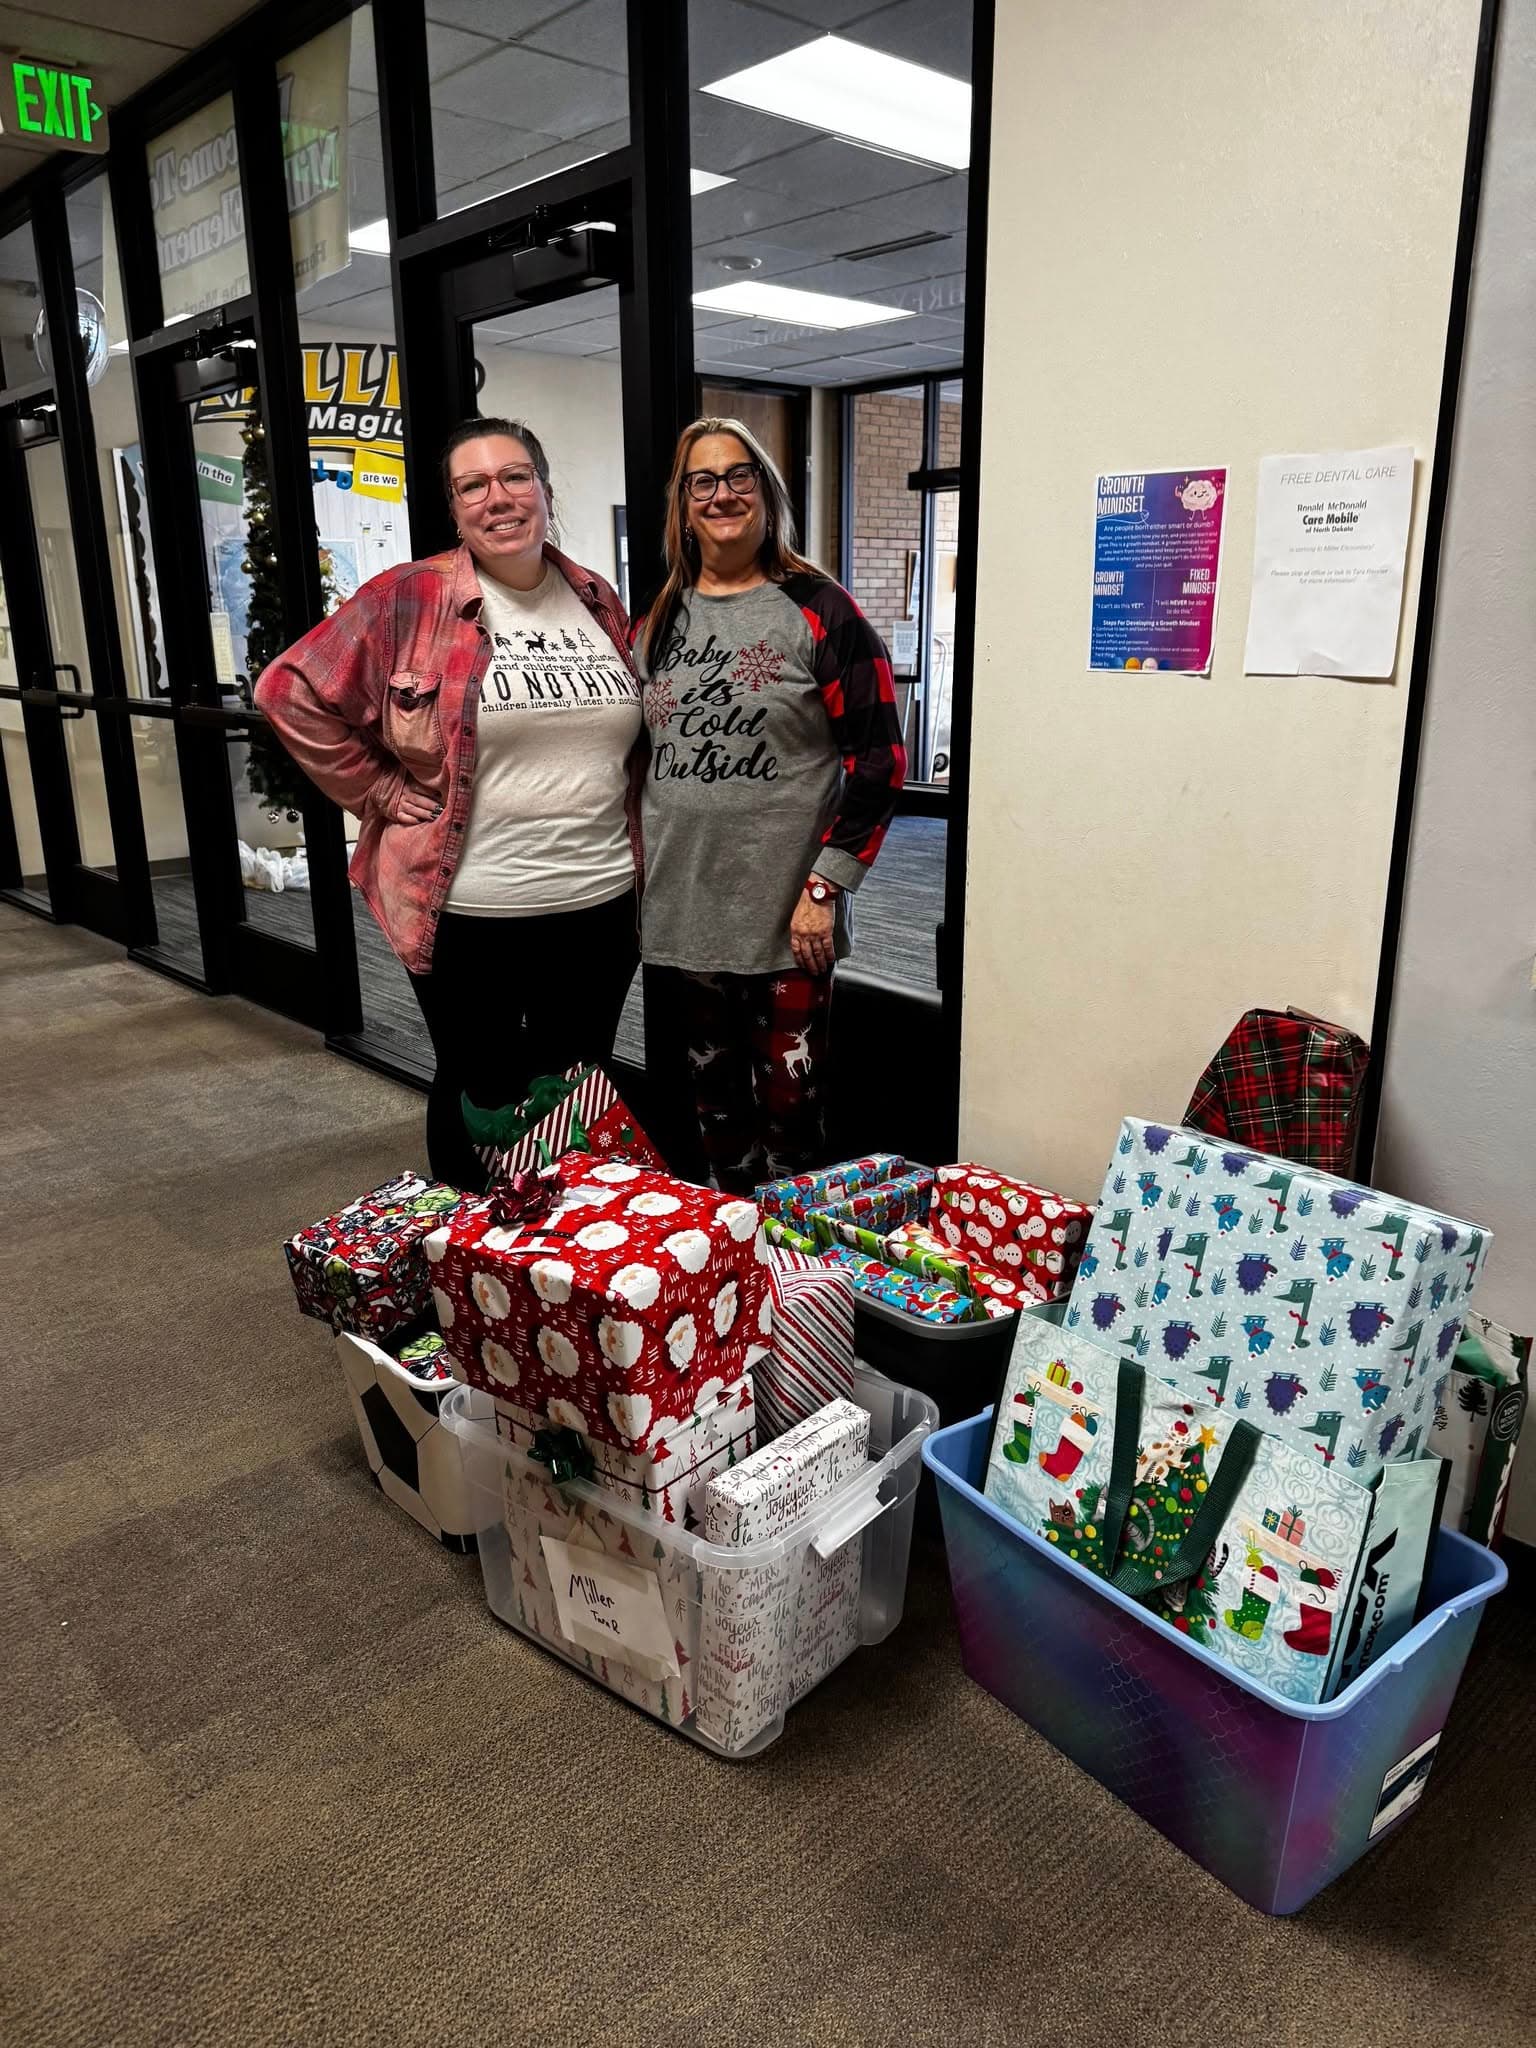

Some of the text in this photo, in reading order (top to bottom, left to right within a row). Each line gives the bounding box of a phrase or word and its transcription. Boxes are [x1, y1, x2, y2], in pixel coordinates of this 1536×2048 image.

[13, 63, 92, 142] EXIT
[198, 462, 233, 484] in the
[362, 474, 398, 485] are we
[1280, 465, 1398, 485] FREE DENTAL CARE
[1100, 475, 1145, 495] GROWTH
[1097, 495, 1145, 515] MINDSET
[1297, 499, 1367, 512] Ronald McDonald
[1302, 511, 1359, 525] Care Mobile
[1114, 525, 1134, 533] people
[1168, 521, 1185, 530] smart
[1193, 520, 1215, 528] dumb?
[1331, 525, 1354, 533] Dakota
[1095, 571, 1125, 584] GROWTH
[1189, 568, 1210, 581] FIXED
[1094, 583, 1125, 596] MINDSET
[1182, 581, 1216, 595] MINDSET
[1103, 619, 1117, 627] Steps
[1126, 619, 1155, 627] Developing
[1179, 619, 1200, 627] Mindset
[532, 654, 557, 662] tree
[559, 654, 584, 663] tops
[655, 634, 740, 683] Baby
[495, 662, 611, 671] and children listen
[521, 670, 640, 699] NOTHING
[482, 702, 527, 712] children
[530, 698, 572, 709] literally
[575, 697, 603, 706] listen
[668, 705, 768, 738] Cold
[654, 739, 779, 784] Outside
[569, 1573, 616, 1609] Miller
[719, 1643, 749, 1662] FELIZ
